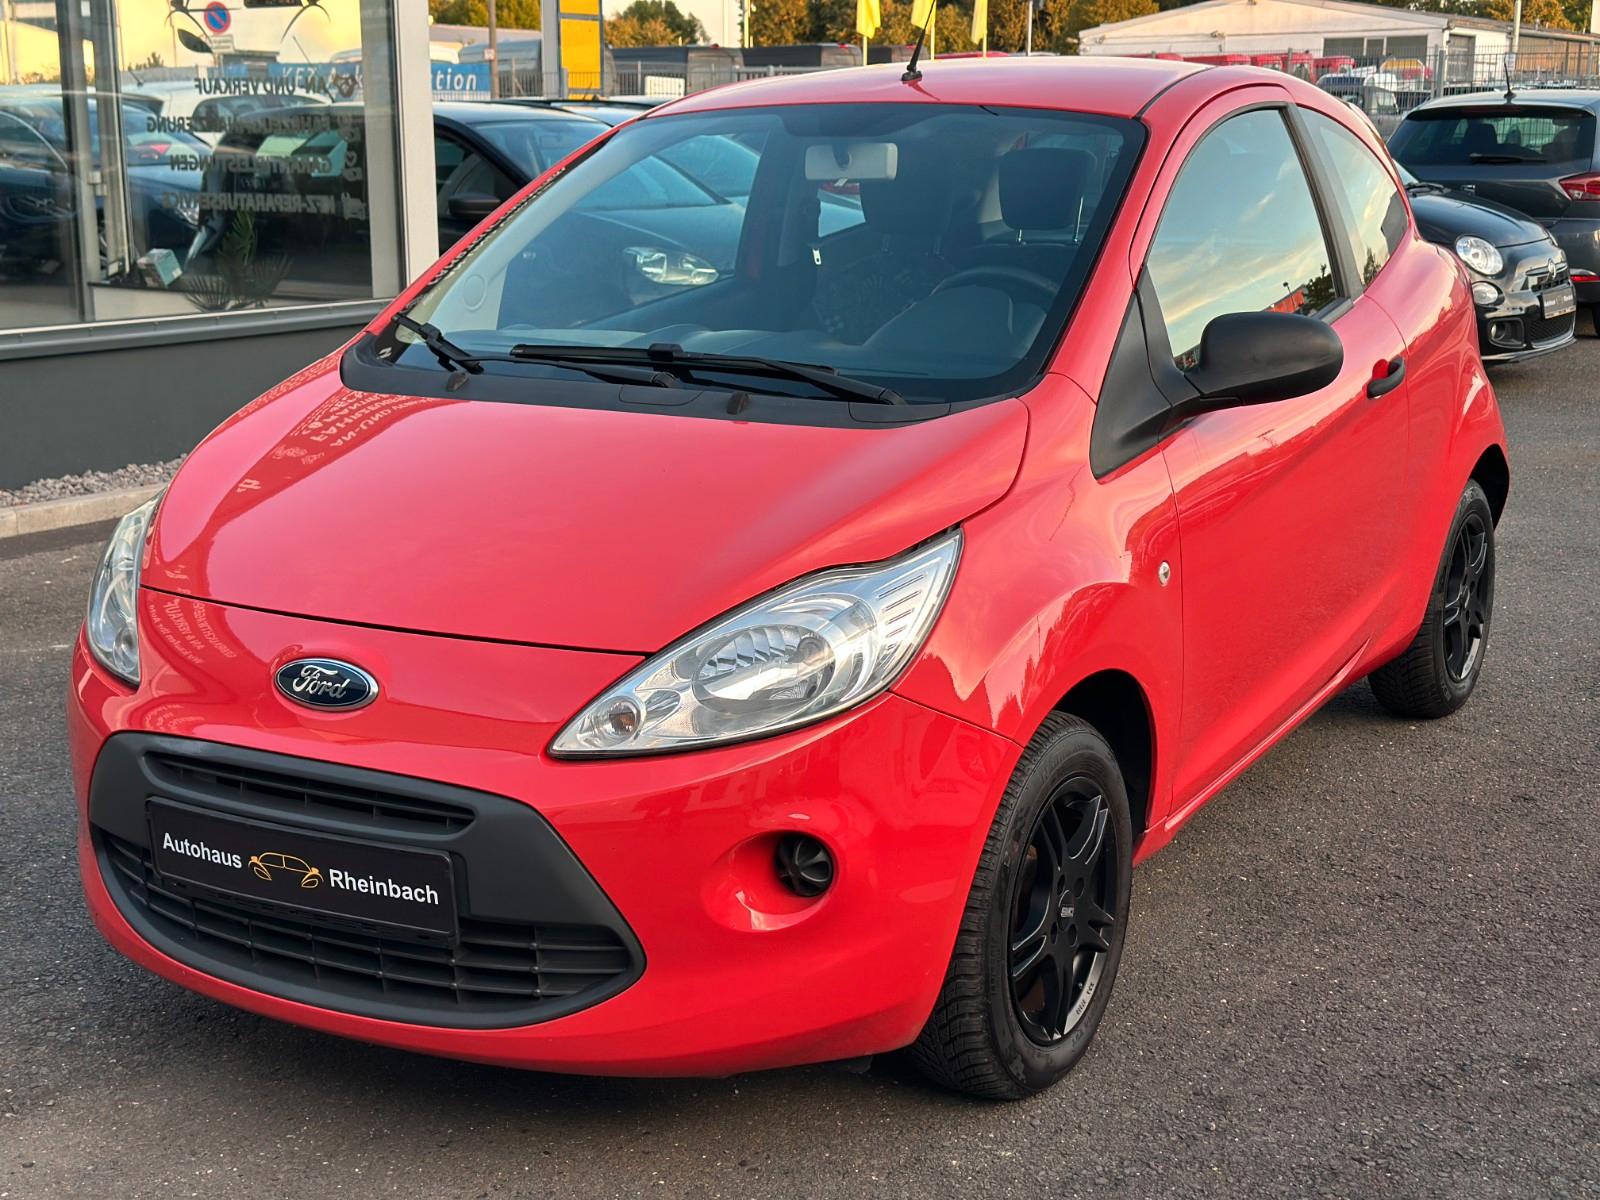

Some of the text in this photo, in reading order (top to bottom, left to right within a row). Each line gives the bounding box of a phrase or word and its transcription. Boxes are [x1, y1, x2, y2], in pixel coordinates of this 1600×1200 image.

[292, 664, 351, 699] Ford
[162, 832, 439, 905] Autohaus Rheinbach
